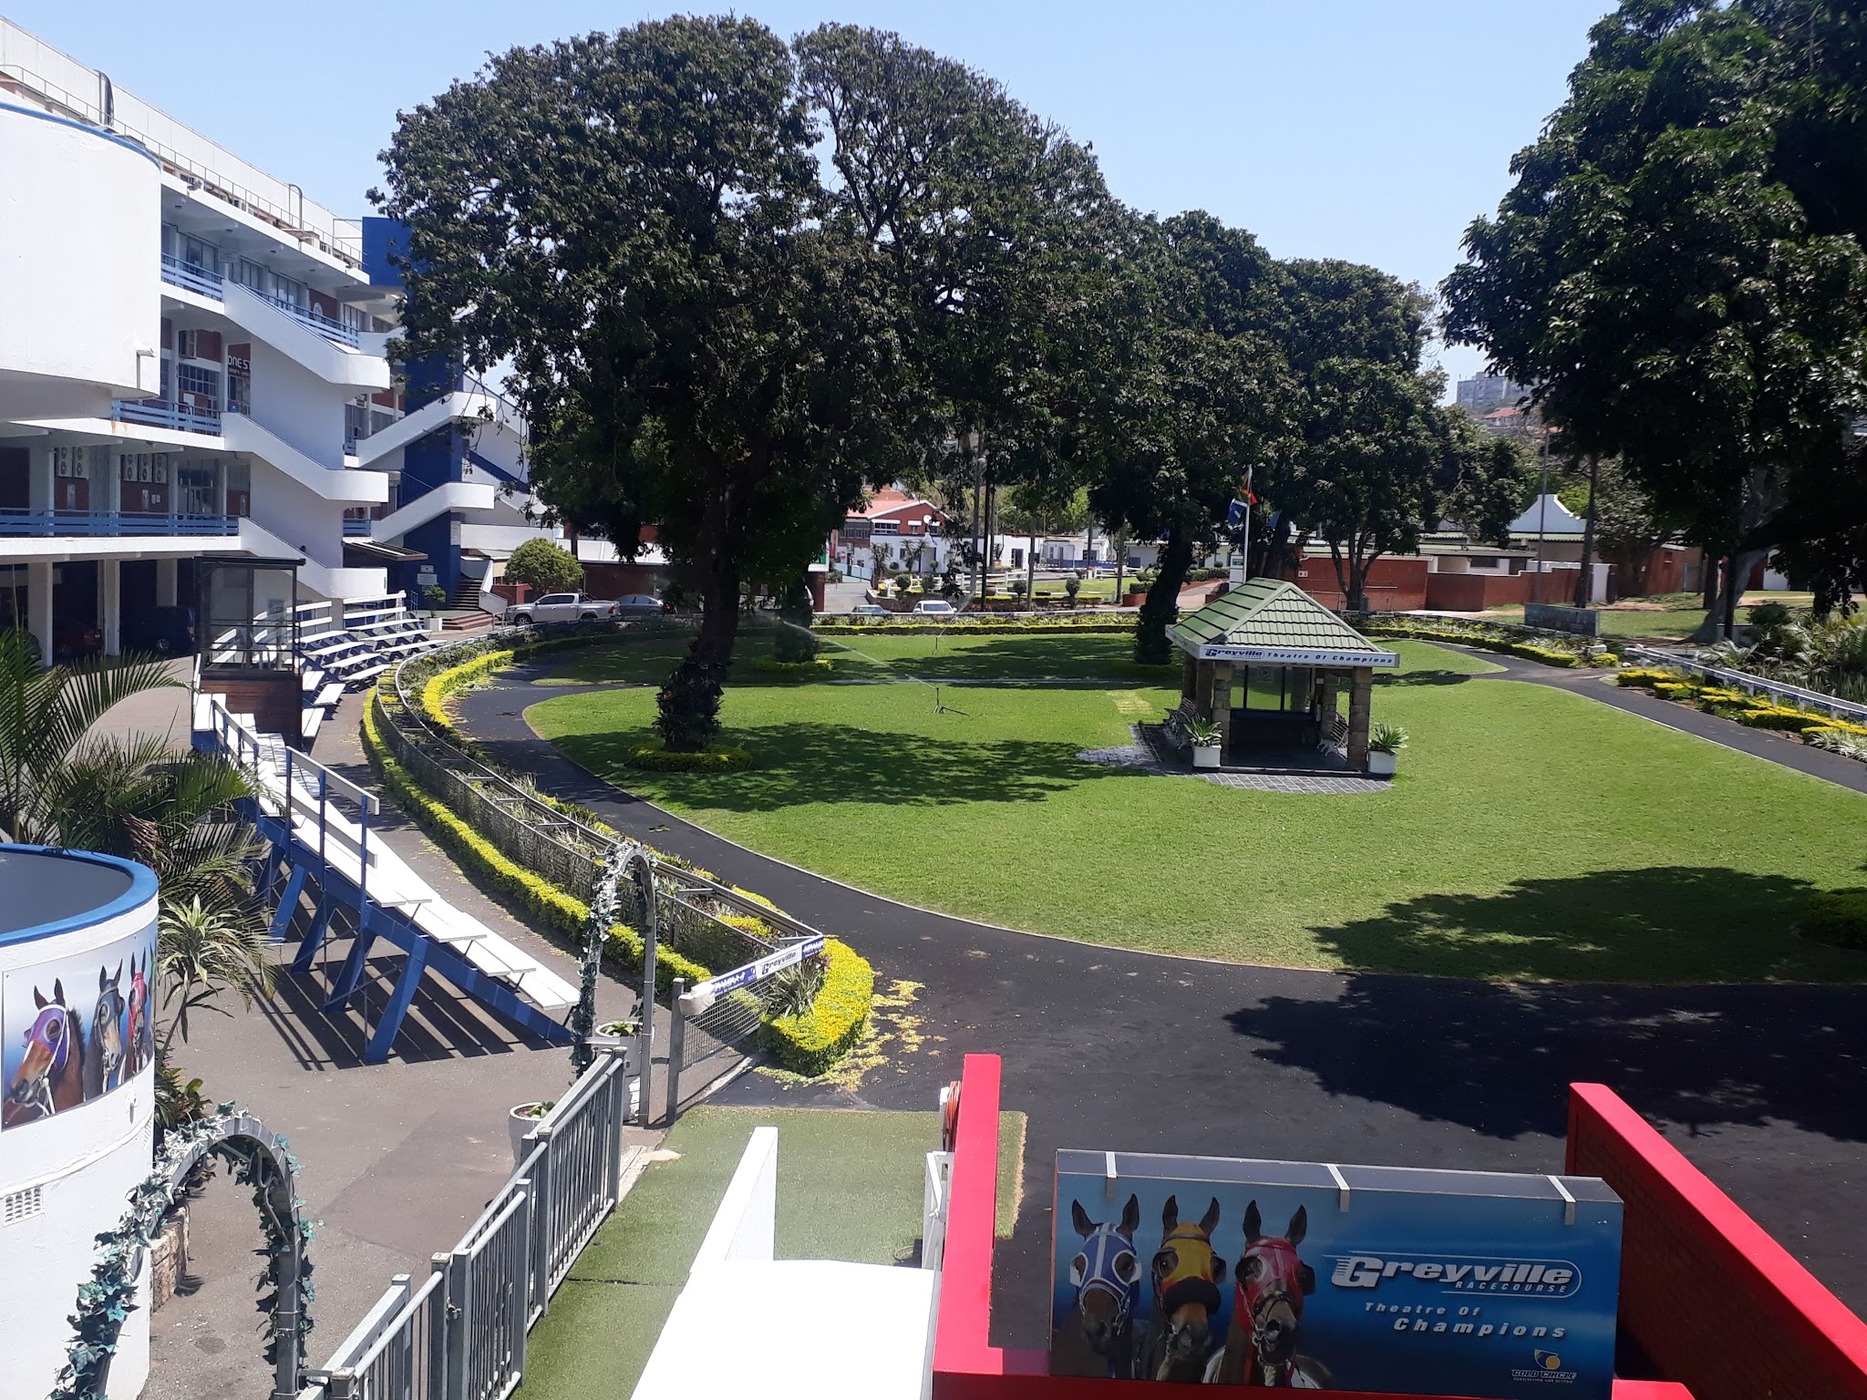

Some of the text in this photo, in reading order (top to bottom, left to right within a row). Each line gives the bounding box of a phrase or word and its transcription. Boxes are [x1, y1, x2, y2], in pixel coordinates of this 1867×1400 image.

[1205, 648, 1263, 657] Greyville
[1267, 652, 1309, 660] Theatre
[1332, 655, 1393, 663] Champions
[761, 951, 797, 975] Greyville
[1331, 1256, 1574, 1289] Greyville
[1455, 1281, 1568, 1293] RACECOURSE
[1365, 1302, 1481, 1316] Theatre Of
[1393, 1317, 1566, 1338] Champions
